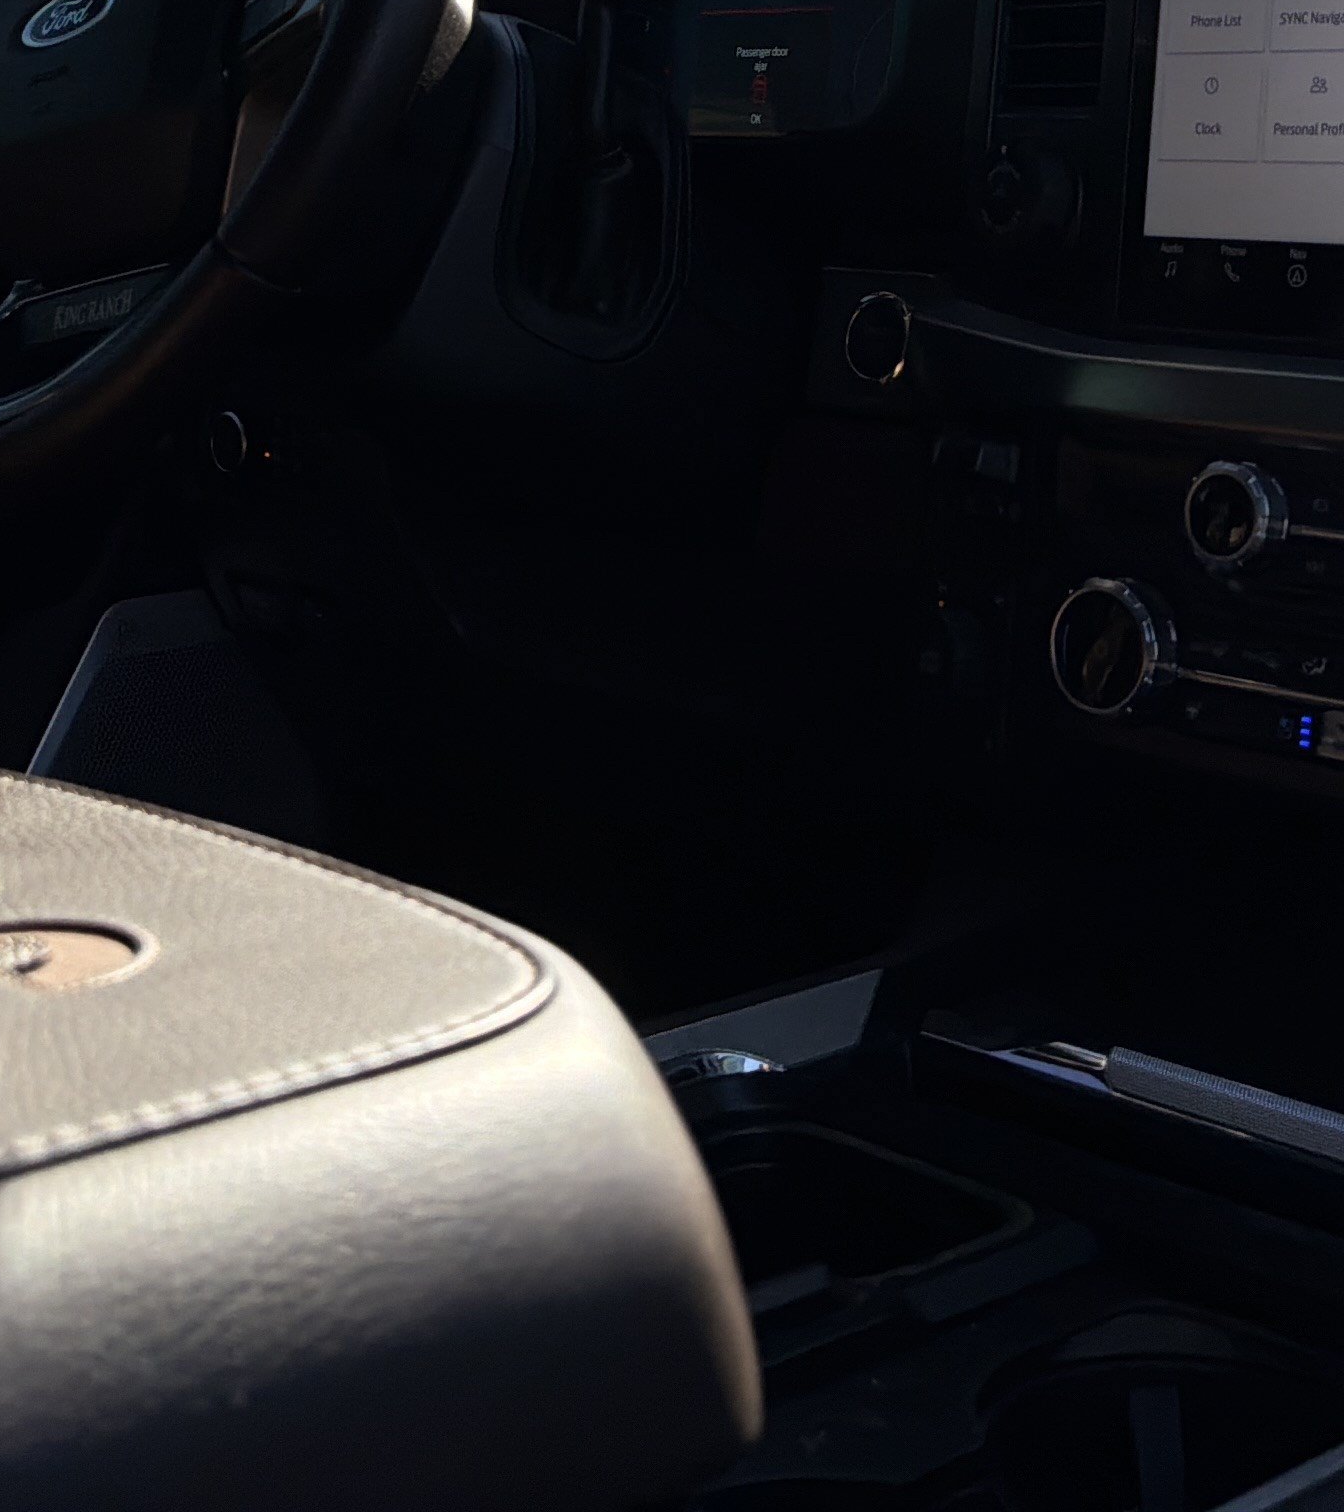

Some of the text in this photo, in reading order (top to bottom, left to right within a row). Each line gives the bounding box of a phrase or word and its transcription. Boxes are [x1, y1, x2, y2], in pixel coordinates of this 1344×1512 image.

[1191, 15, 1242, 27] Phone List
[1279, 12, 1308, 26] SYNC
[1195, 123, 1221, 135] Clock
[1274, 123, 1318, 136] Personal
